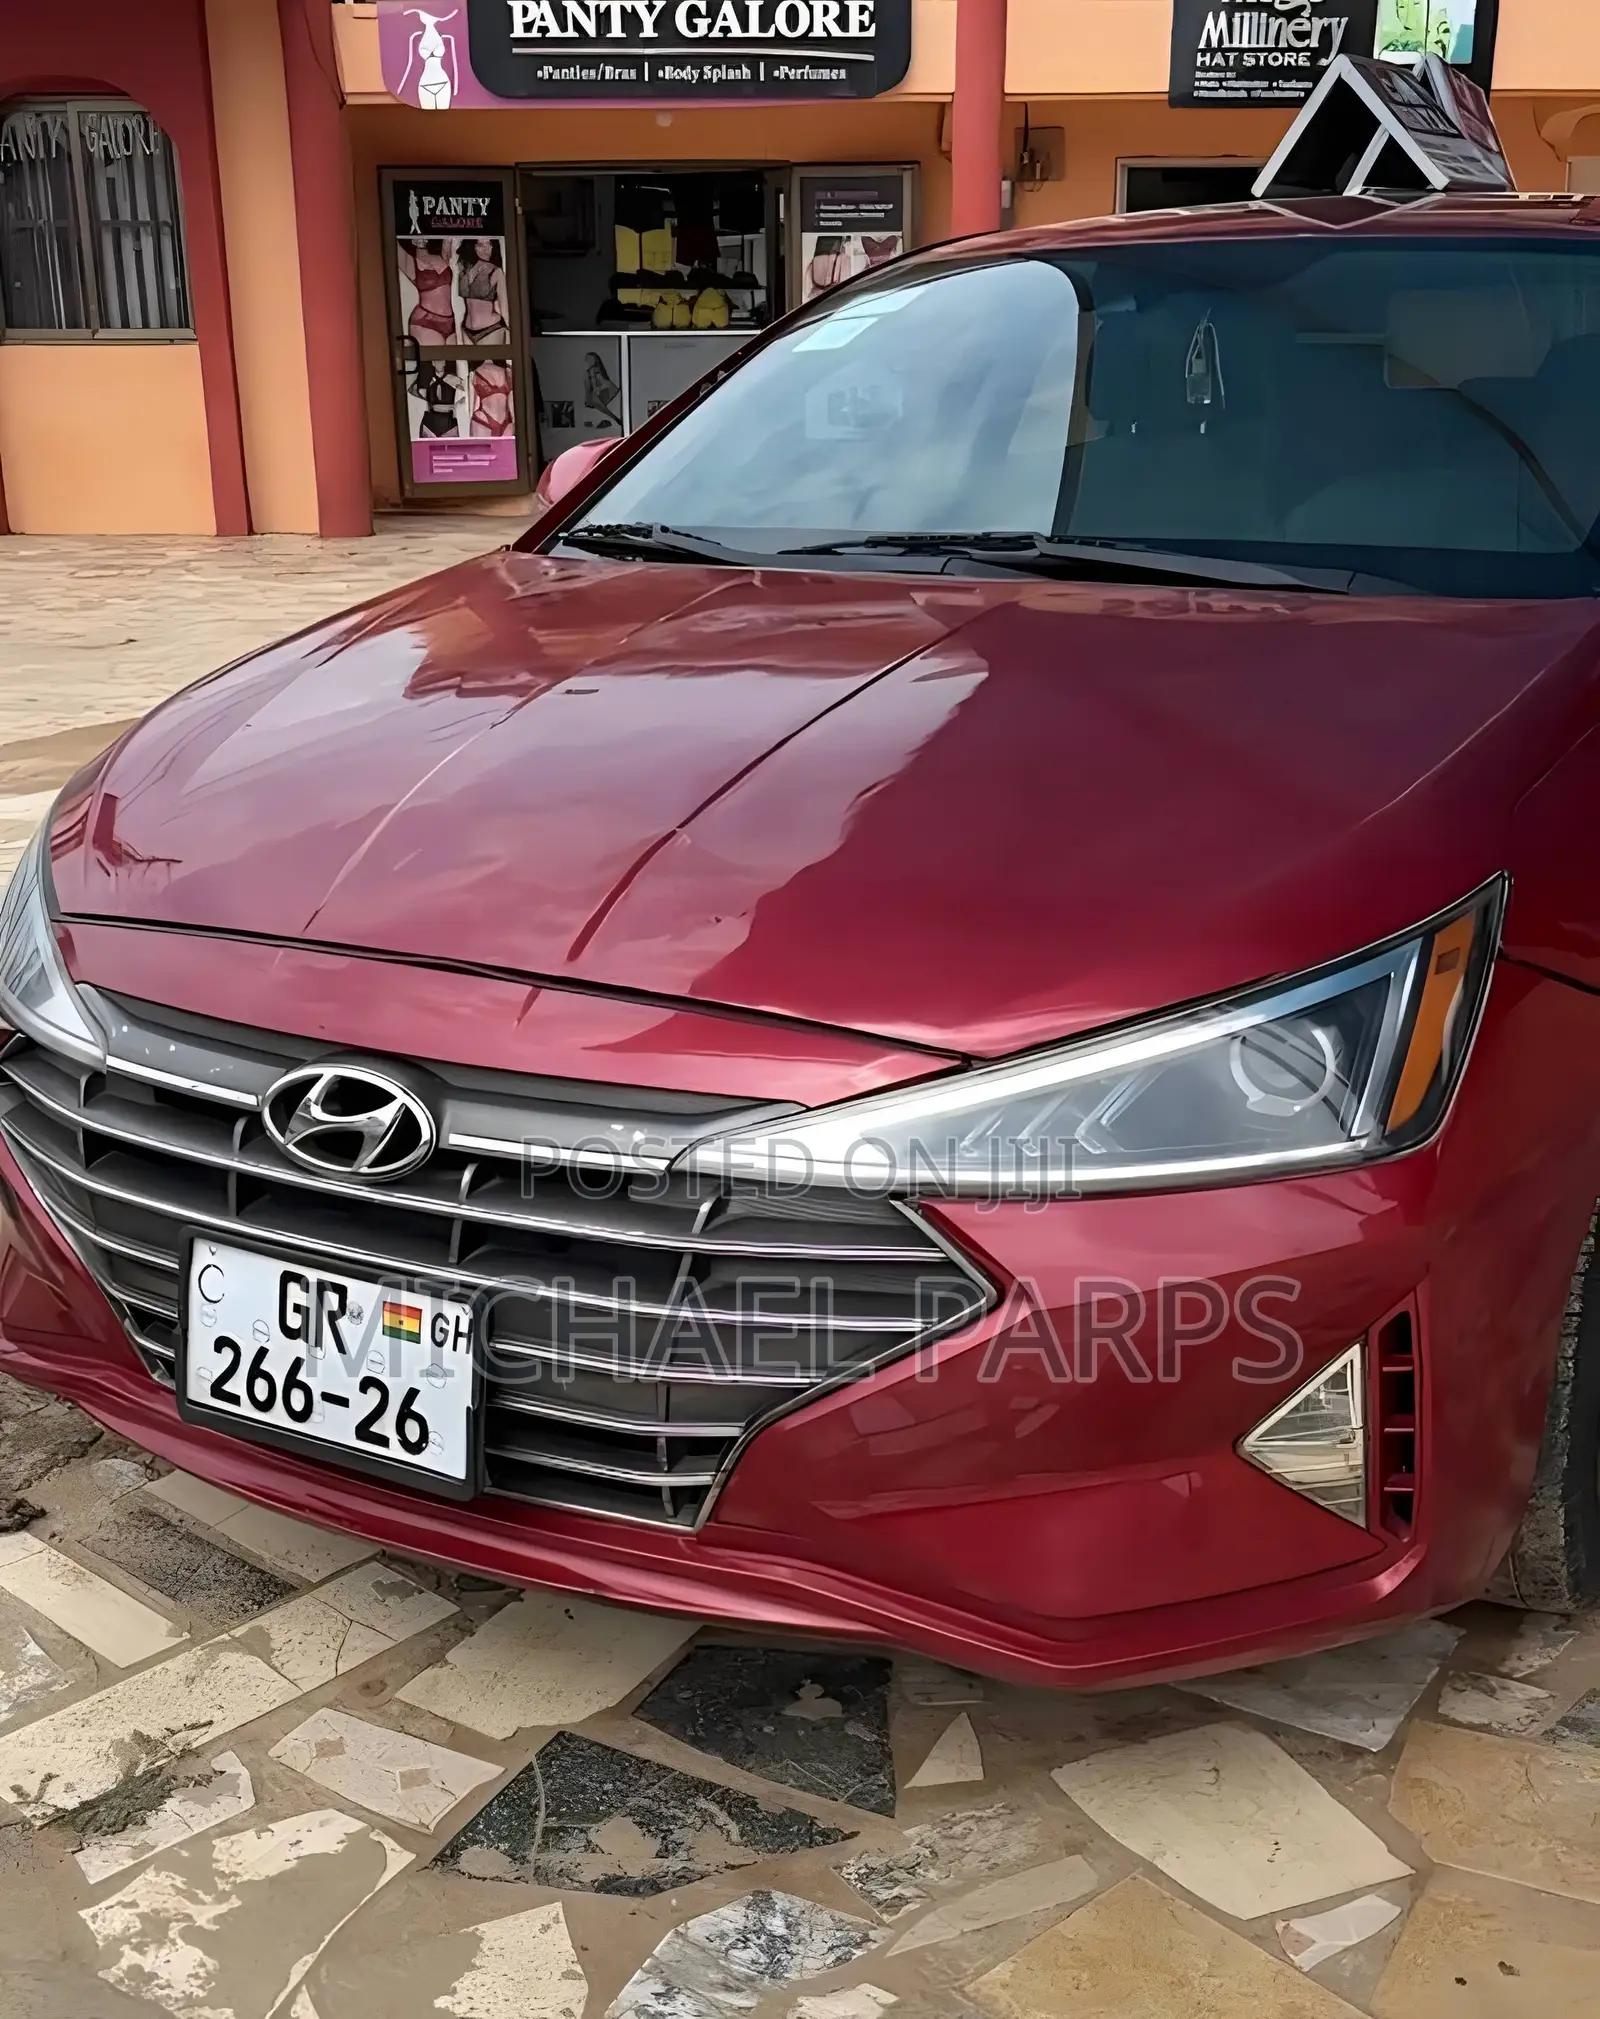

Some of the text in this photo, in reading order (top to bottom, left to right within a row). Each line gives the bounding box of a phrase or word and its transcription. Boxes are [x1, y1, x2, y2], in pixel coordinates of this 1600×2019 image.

[509, 0, 876, 38] PANTY GALORE
[1198, 11, 1349, 66] Millinery
[1197, 52, 1311, 66] HAT STORE
[422, 196, 491, 216] PANTY
[278, 1269, 348, 1356] GR
[430, 1312, 474, 1354] GH
[210, 1335, 430, 1456] 266-26
